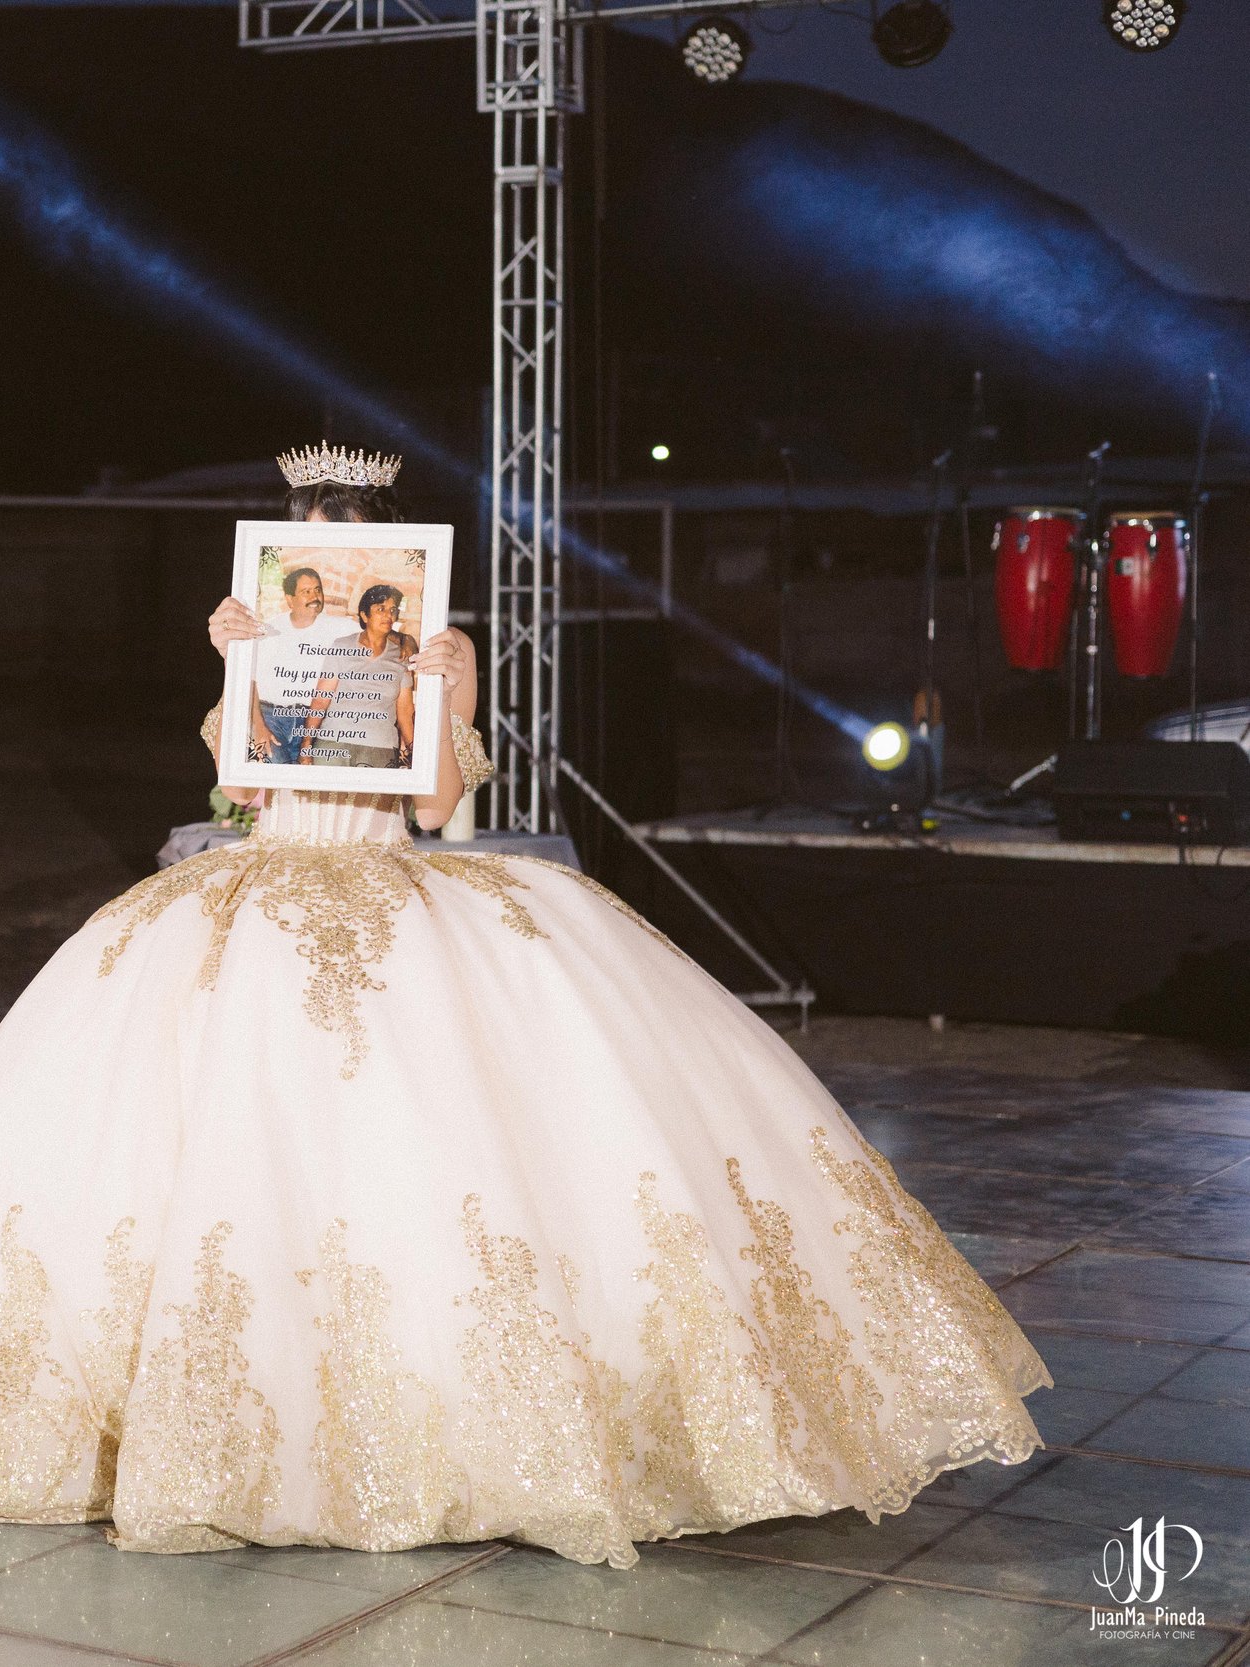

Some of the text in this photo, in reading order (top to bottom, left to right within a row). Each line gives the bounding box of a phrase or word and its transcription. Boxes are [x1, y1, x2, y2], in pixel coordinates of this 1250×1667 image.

[274, 666, 393, 683] Hoy ya no estan con
[367, 692, 381, 701] en
[273, 705, 388, 723] nuestros corazones
[291, 725, 367, 742] viviran para
[300, 745, 352, 761] siempre.
